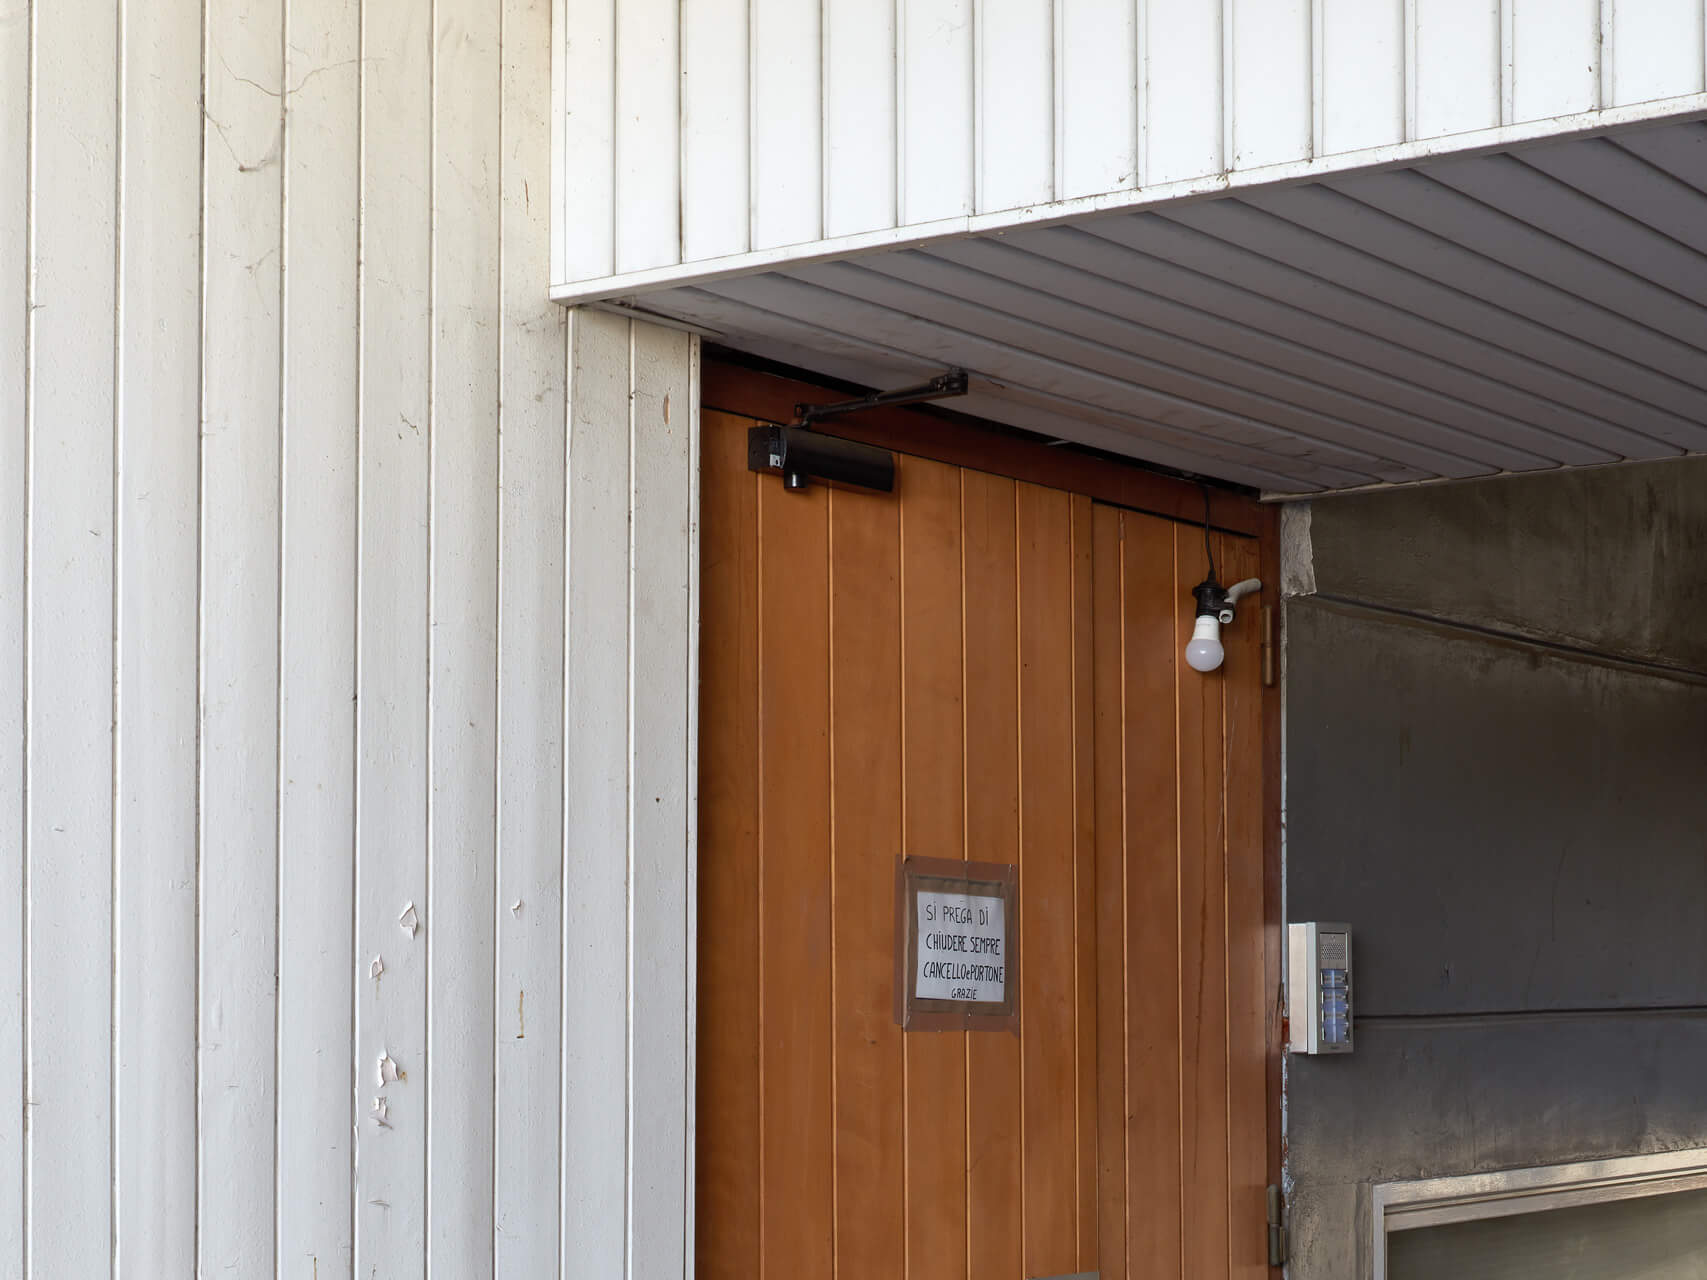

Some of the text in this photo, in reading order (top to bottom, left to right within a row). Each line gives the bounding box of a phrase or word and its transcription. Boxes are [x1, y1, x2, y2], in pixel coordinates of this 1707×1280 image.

[943, 905, 973, 925] PREGA
[926, 930, 1001, 956] CHIUDERE SEMPRE
[951, 987, 977, 1000] GRAZIE
